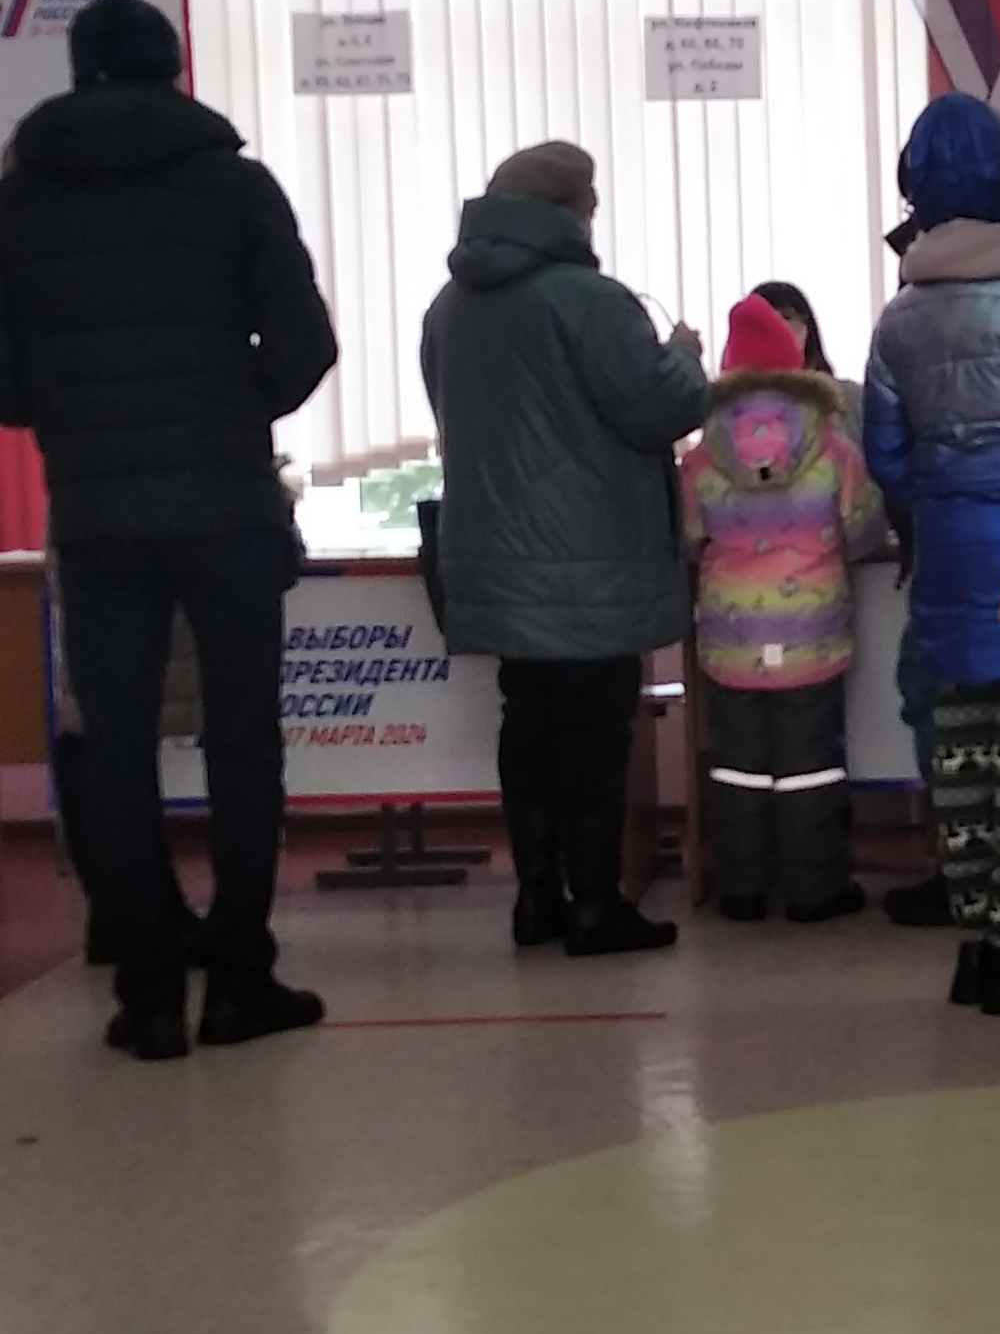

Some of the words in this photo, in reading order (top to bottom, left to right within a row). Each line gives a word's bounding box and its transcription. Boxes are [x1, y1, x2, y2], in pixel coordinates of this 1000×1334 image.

[285, 624, 414, 650] ВЫБОРЫ
[279, 691, 375, 717] ОССИИ
[308, 723, 377, 746] МАРТА
[379, 721, 428, 745] 2024
